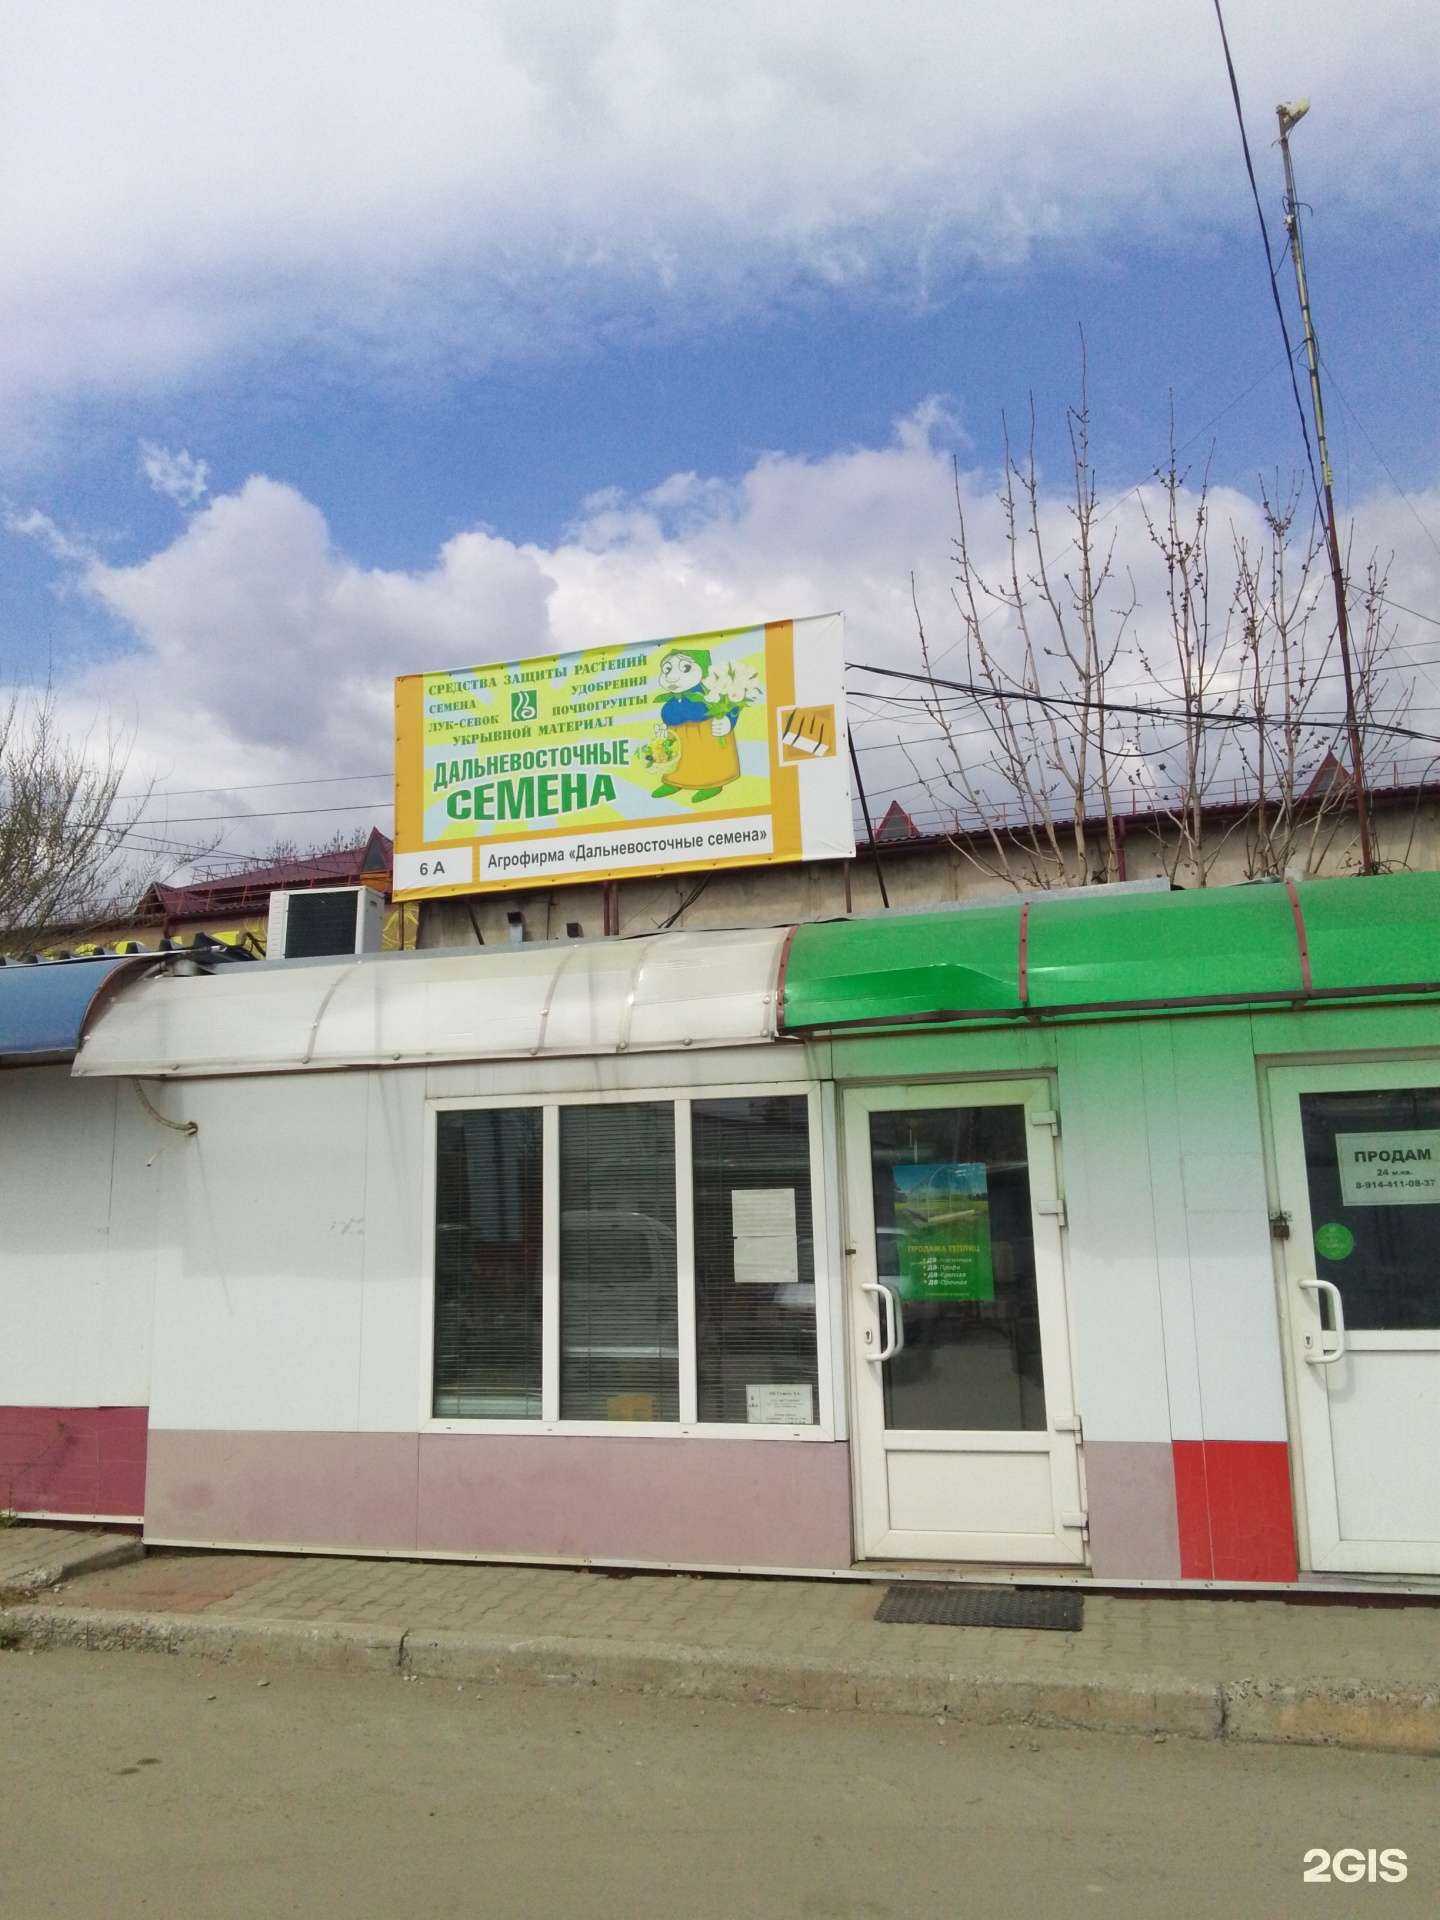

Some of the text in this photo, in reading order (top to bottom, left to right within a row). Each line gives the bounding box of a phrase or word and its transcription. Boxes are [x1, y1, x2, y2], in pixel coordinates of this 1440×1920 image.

[428, 653, 648, 696] СРЕДСТВА ЗАЩИТЫ РАСТЕНИЙ
[571, 675, 648, 696] УДОБРЕНИЯ
[429, 699, 477, 715] СЕМЕНА
[552, 694, 648, 717] ПОЧВОГРУНТЫ
[428, 714, 500, 733] ЛУК-СЕВОК
[452, 716, 614, 747] УКРЫВНОЙ МАТЕРИАЛ
[433, 739, 630, 792] ДАЛЬНЕВОСТОЧНЫЕ
[446, 772, 617, 821] СЕМЕНА
[488, 828, 768, 873] Агрофирма «Дальневосточные семена»
[419, 862, 446, 877] 6 А
[1354, 1148, 1432, 1164] ПРОДАМ
[1376, 1168, 1390, 1177] 24
